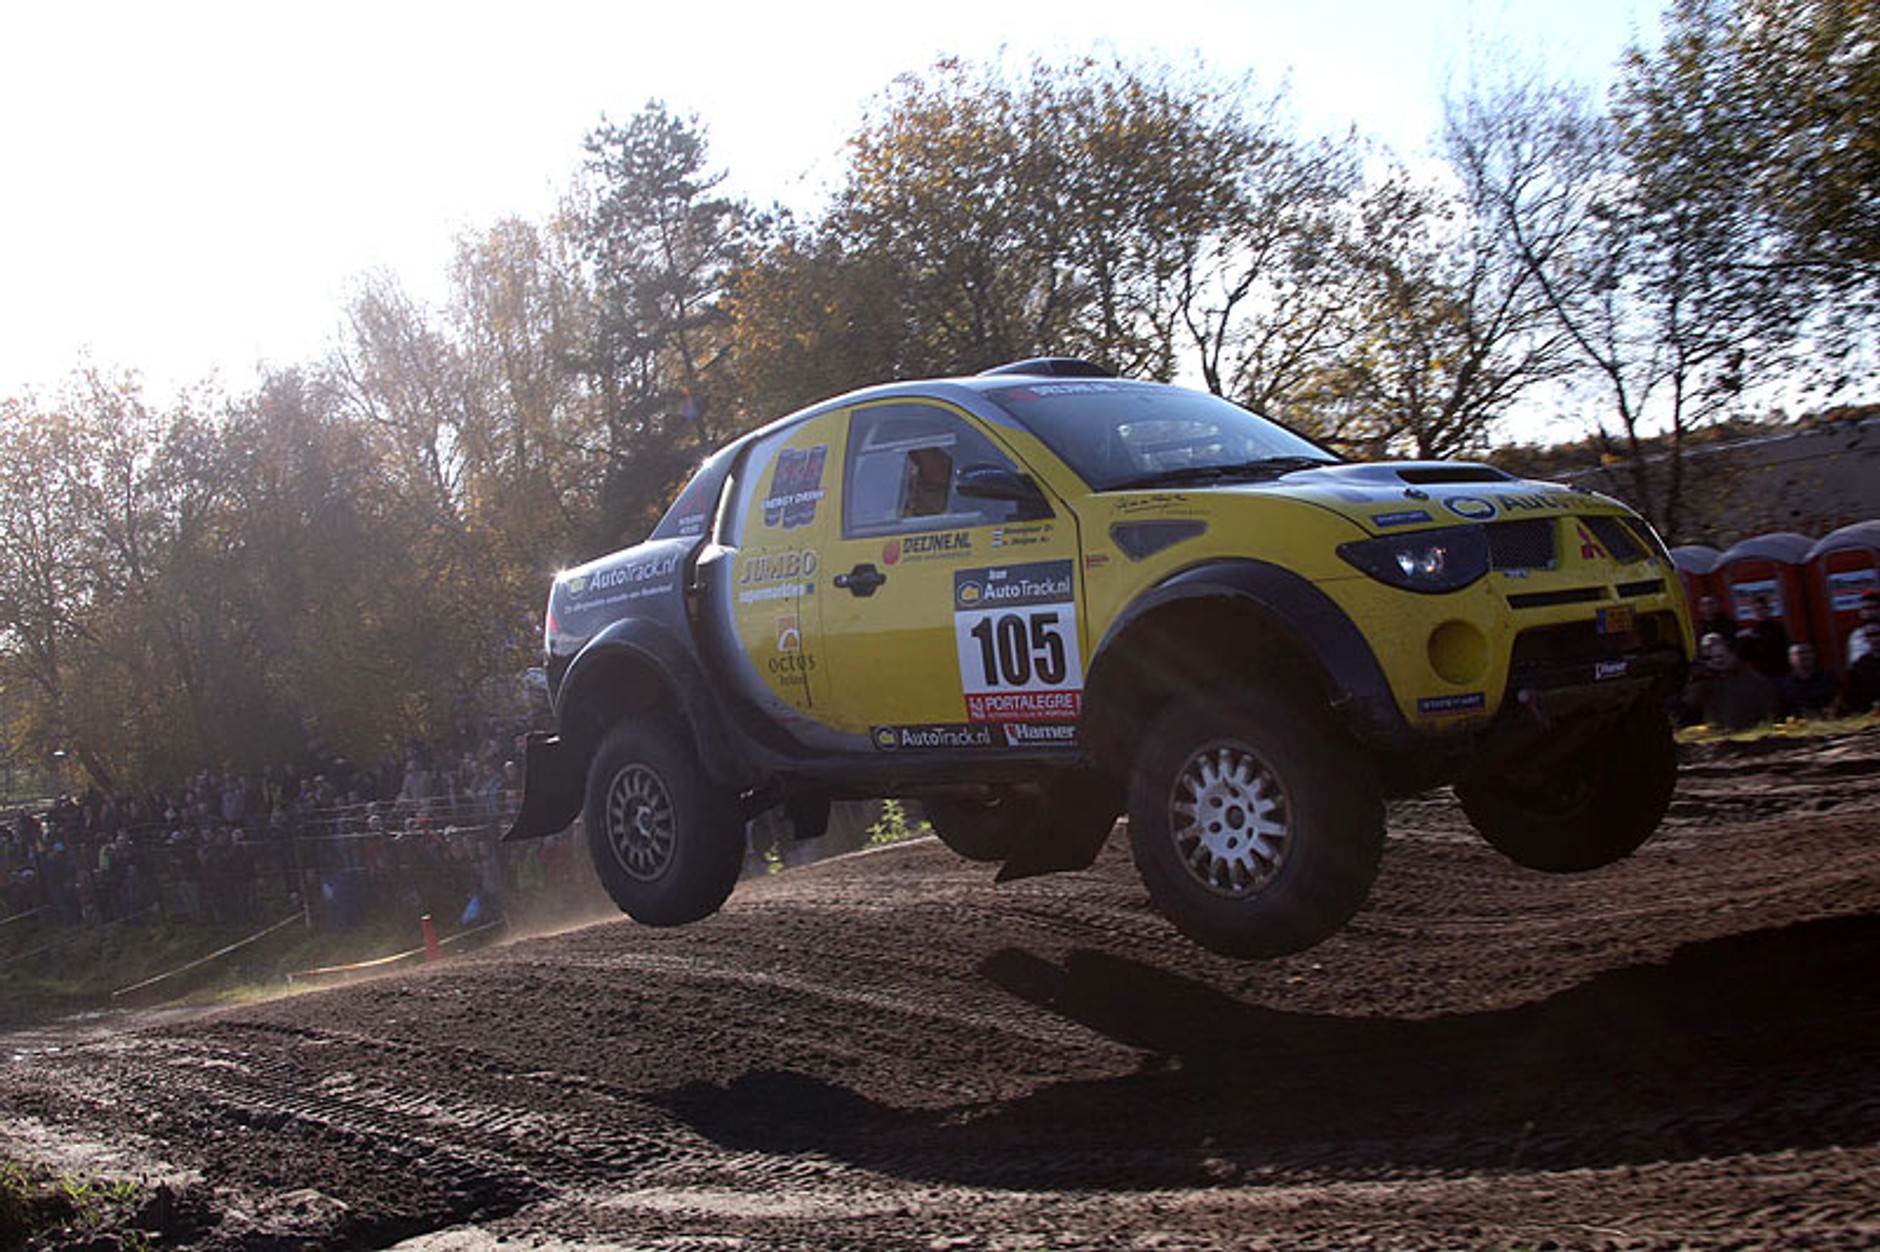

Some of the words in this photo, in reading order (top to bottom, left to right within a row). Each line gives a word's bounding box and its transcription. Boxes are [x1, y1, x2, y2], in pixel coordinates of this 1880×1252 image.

[589, 554, 679, 591] AutoTrack.nl
[740, 550, 817, 585] JUMBO
[984, 576, 1071, 600] AutoTrack.nl
[970, 612, 1066, 687] 105
[986, 693, 1074, 713] PORTALEGRE
[902, 727, 991, 747] AutoTrack.nl
[1015, 723, 1076, 740] Hamer
